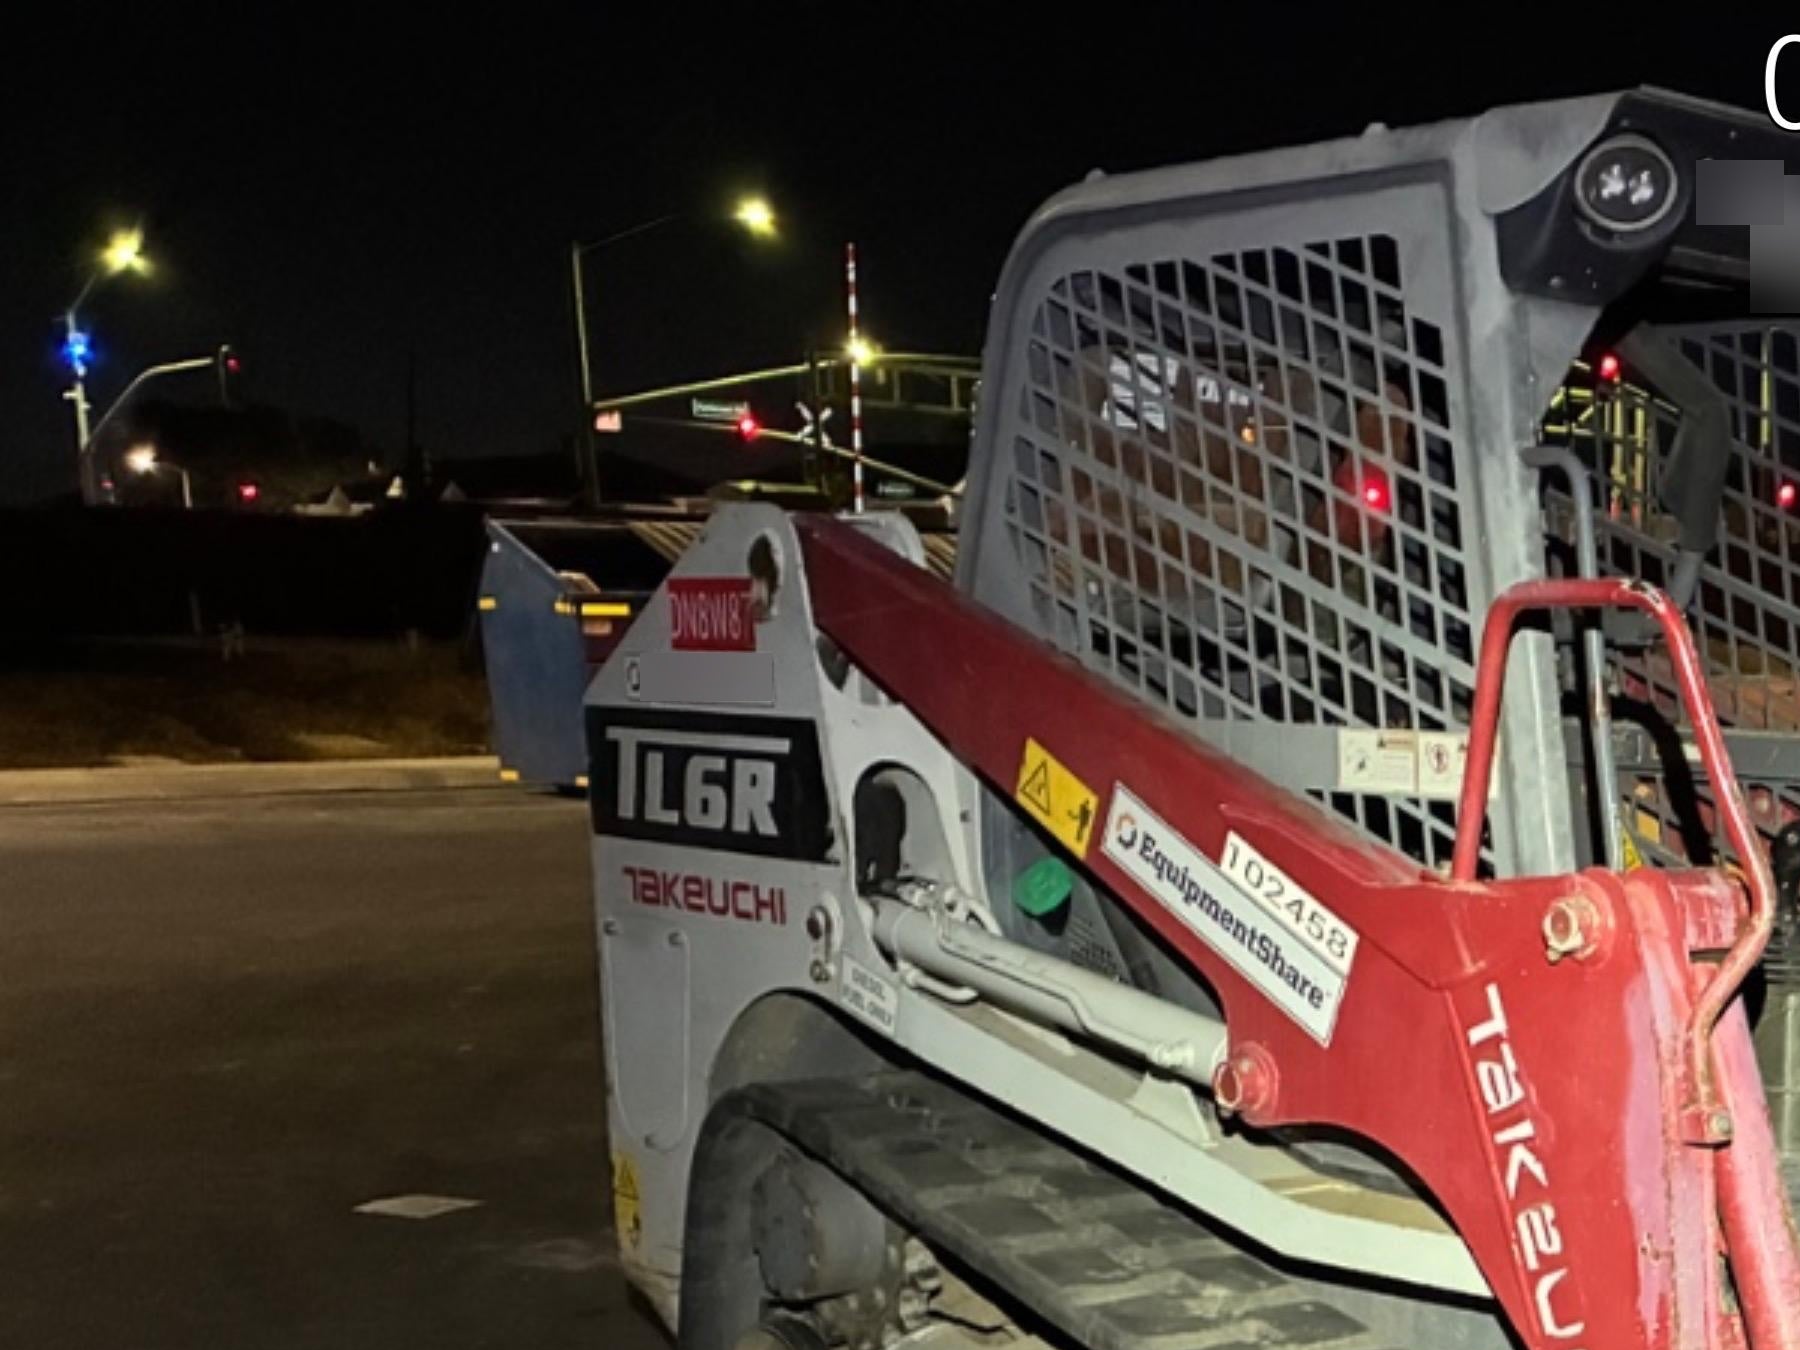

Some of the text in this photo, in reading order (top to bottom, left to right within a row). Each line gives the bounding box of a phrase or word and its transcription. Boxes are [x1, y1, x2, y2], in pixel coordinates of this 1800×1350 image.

[605, 726, 790, 837] TL6R
[1139, 831, 1325, 1009] EquipmentShare
[1228, 841, 1349, 959] 102458
